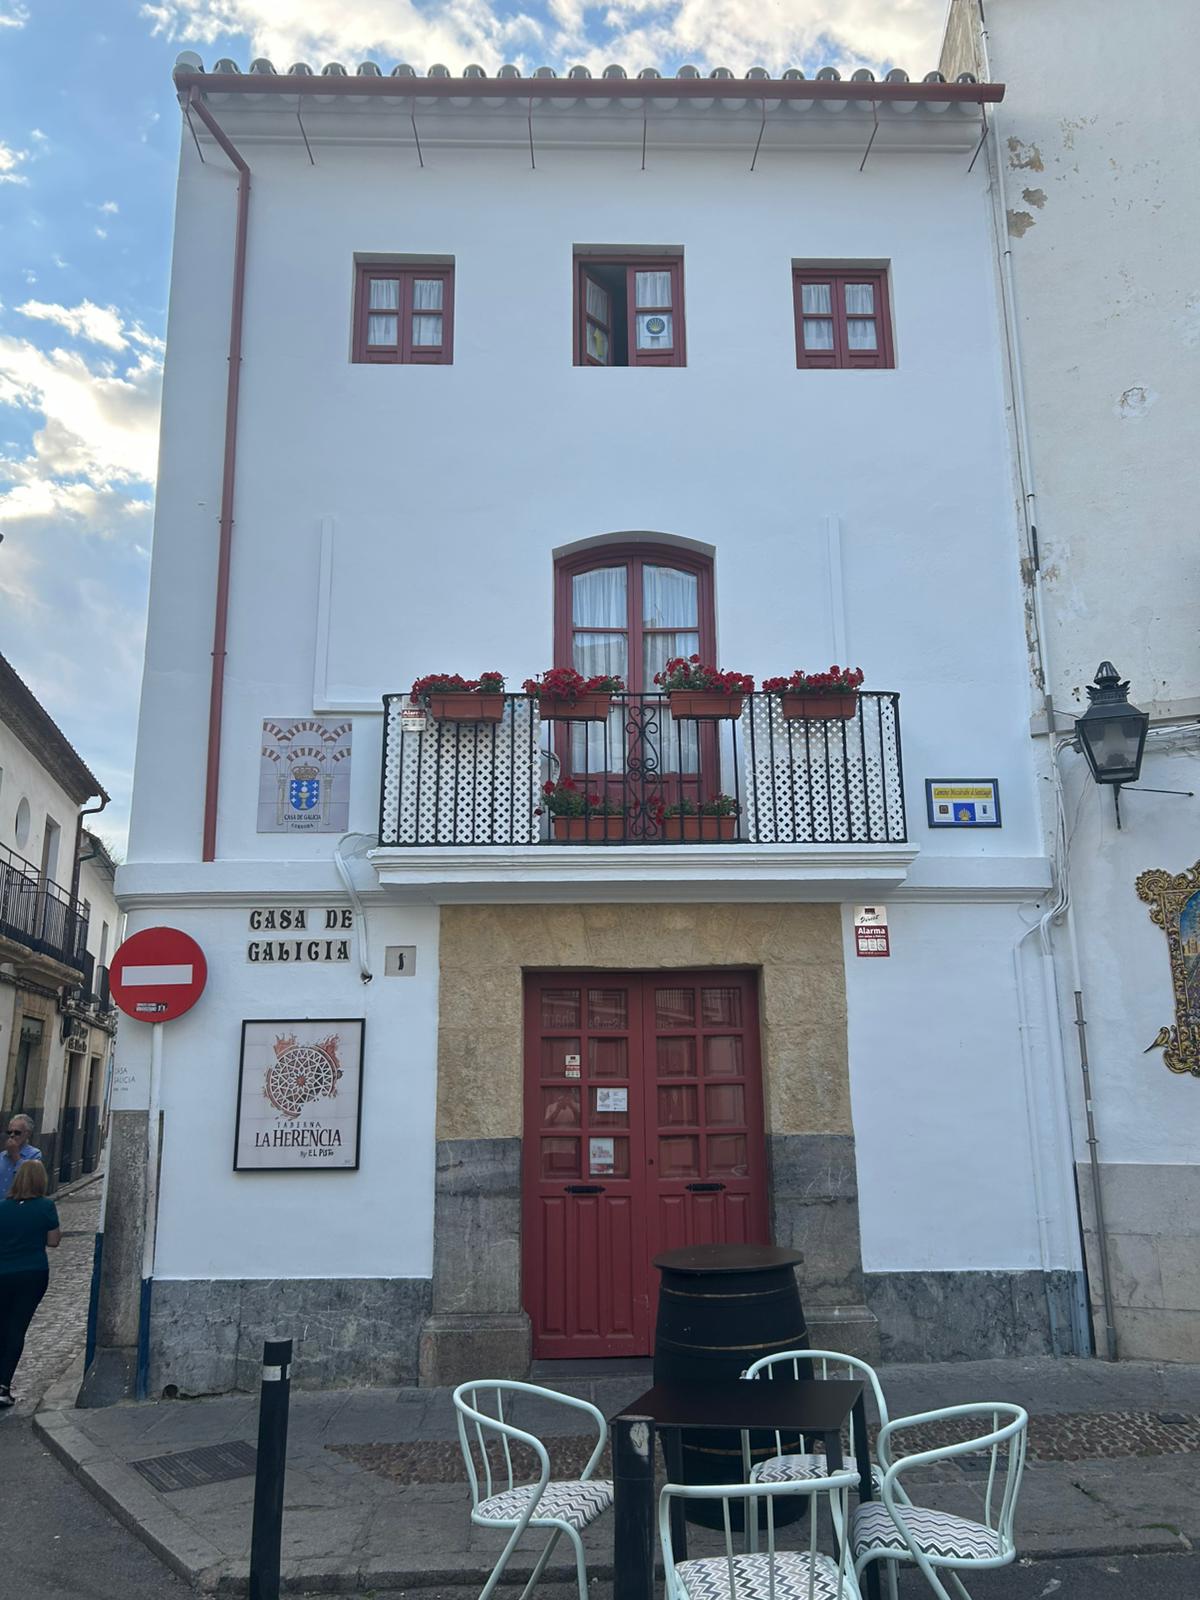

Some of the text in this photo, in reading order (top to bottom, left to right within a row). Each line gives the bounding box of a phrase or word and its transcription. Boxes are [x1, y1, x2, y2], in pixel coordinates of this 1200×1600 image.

[249, 909, 353, 930] CASA DE
[858, 927, 886, 935] Alarma
[248, 940, 350, 962] GALICIA
[277, 1121, 322, 1129] TABERNA
[255, 1129, 342, 1147] LA HERENCIA
[308, 1149, 317, 1157] EL
